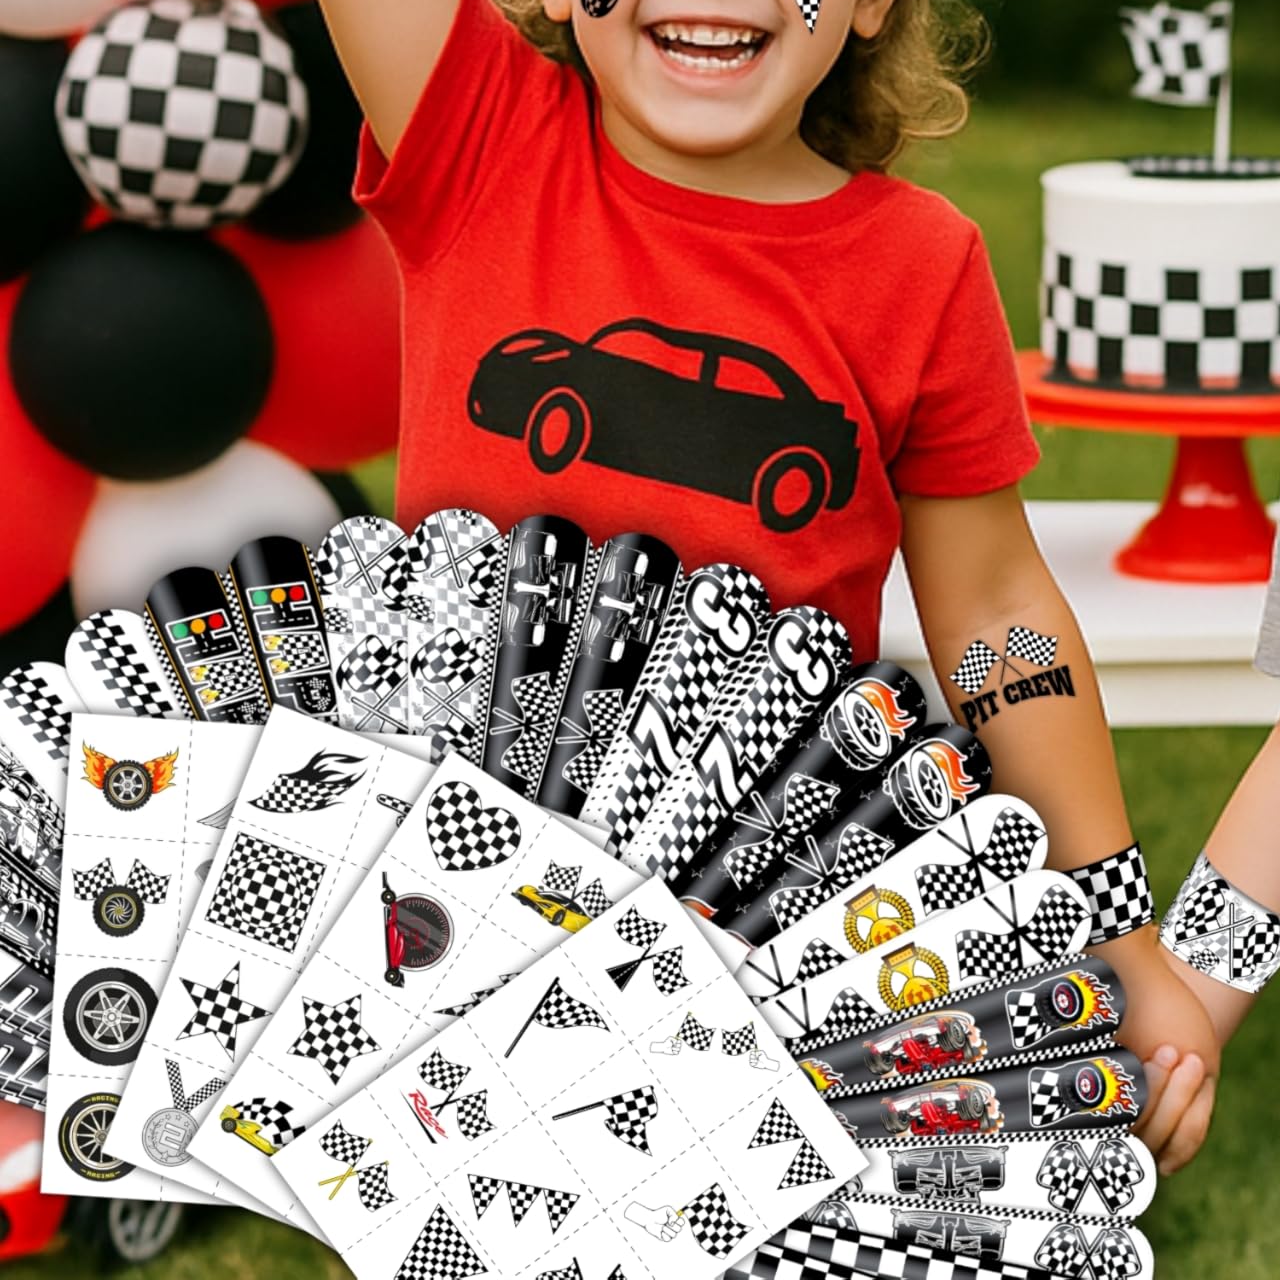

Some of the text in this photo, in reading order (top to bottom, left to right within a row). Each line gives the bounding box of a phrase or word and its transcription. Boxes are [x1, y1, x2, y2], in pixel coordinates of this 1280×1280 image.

[960, 664, 1077, 734] PIT CREW
[160, 1122, 187, 1151] 2
[408, 1087, 449, 1140] Race
